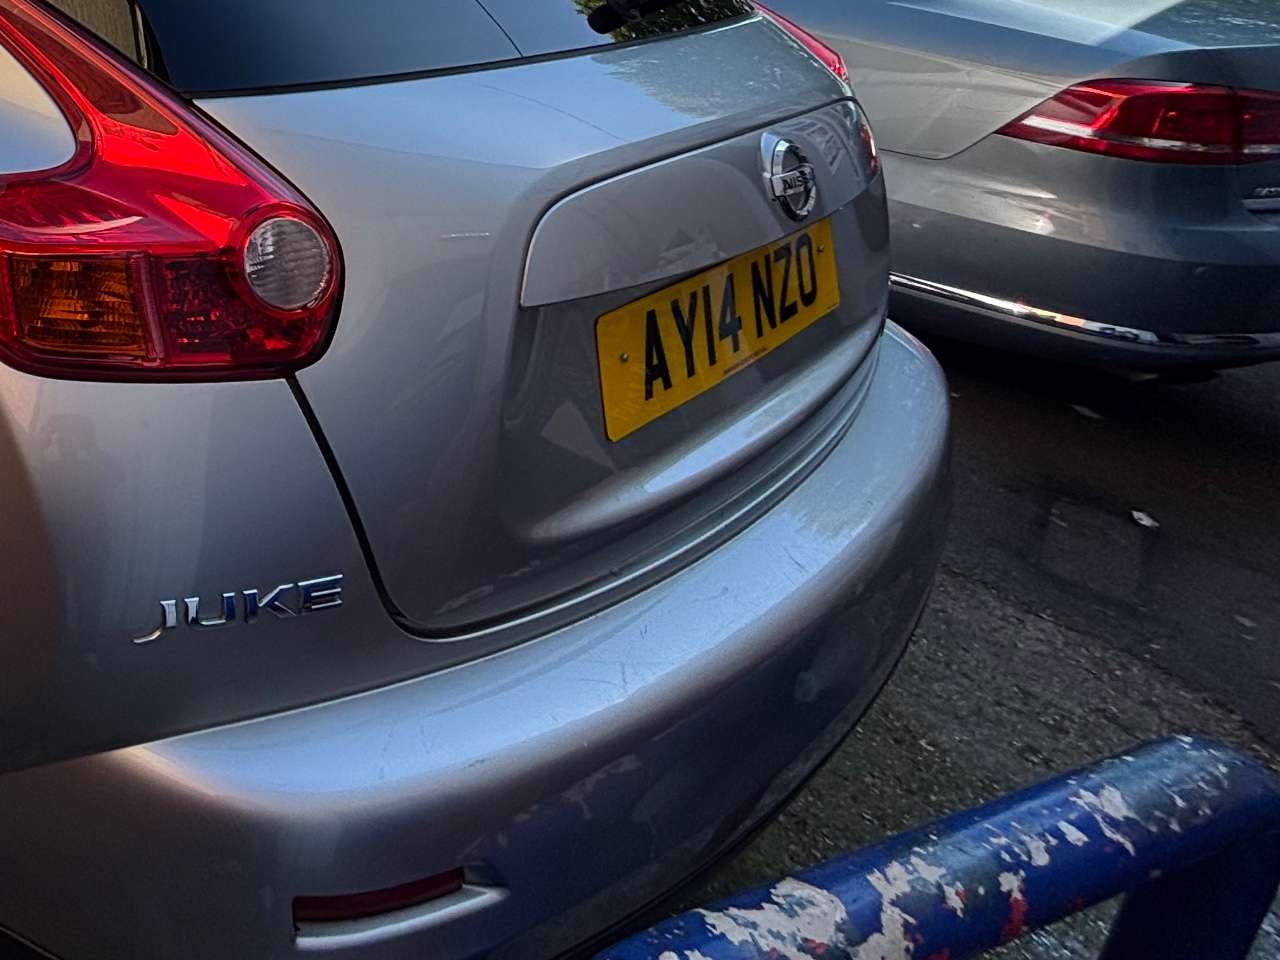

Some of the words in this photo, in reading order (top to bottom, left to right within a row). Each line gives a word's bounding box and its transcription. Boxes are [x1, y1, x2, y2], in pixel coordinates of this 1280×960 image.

[644, 272, 742, 401] AY14
[751, 233, 818, 338] NZO
[133, 574, 343, 643] JUKE
